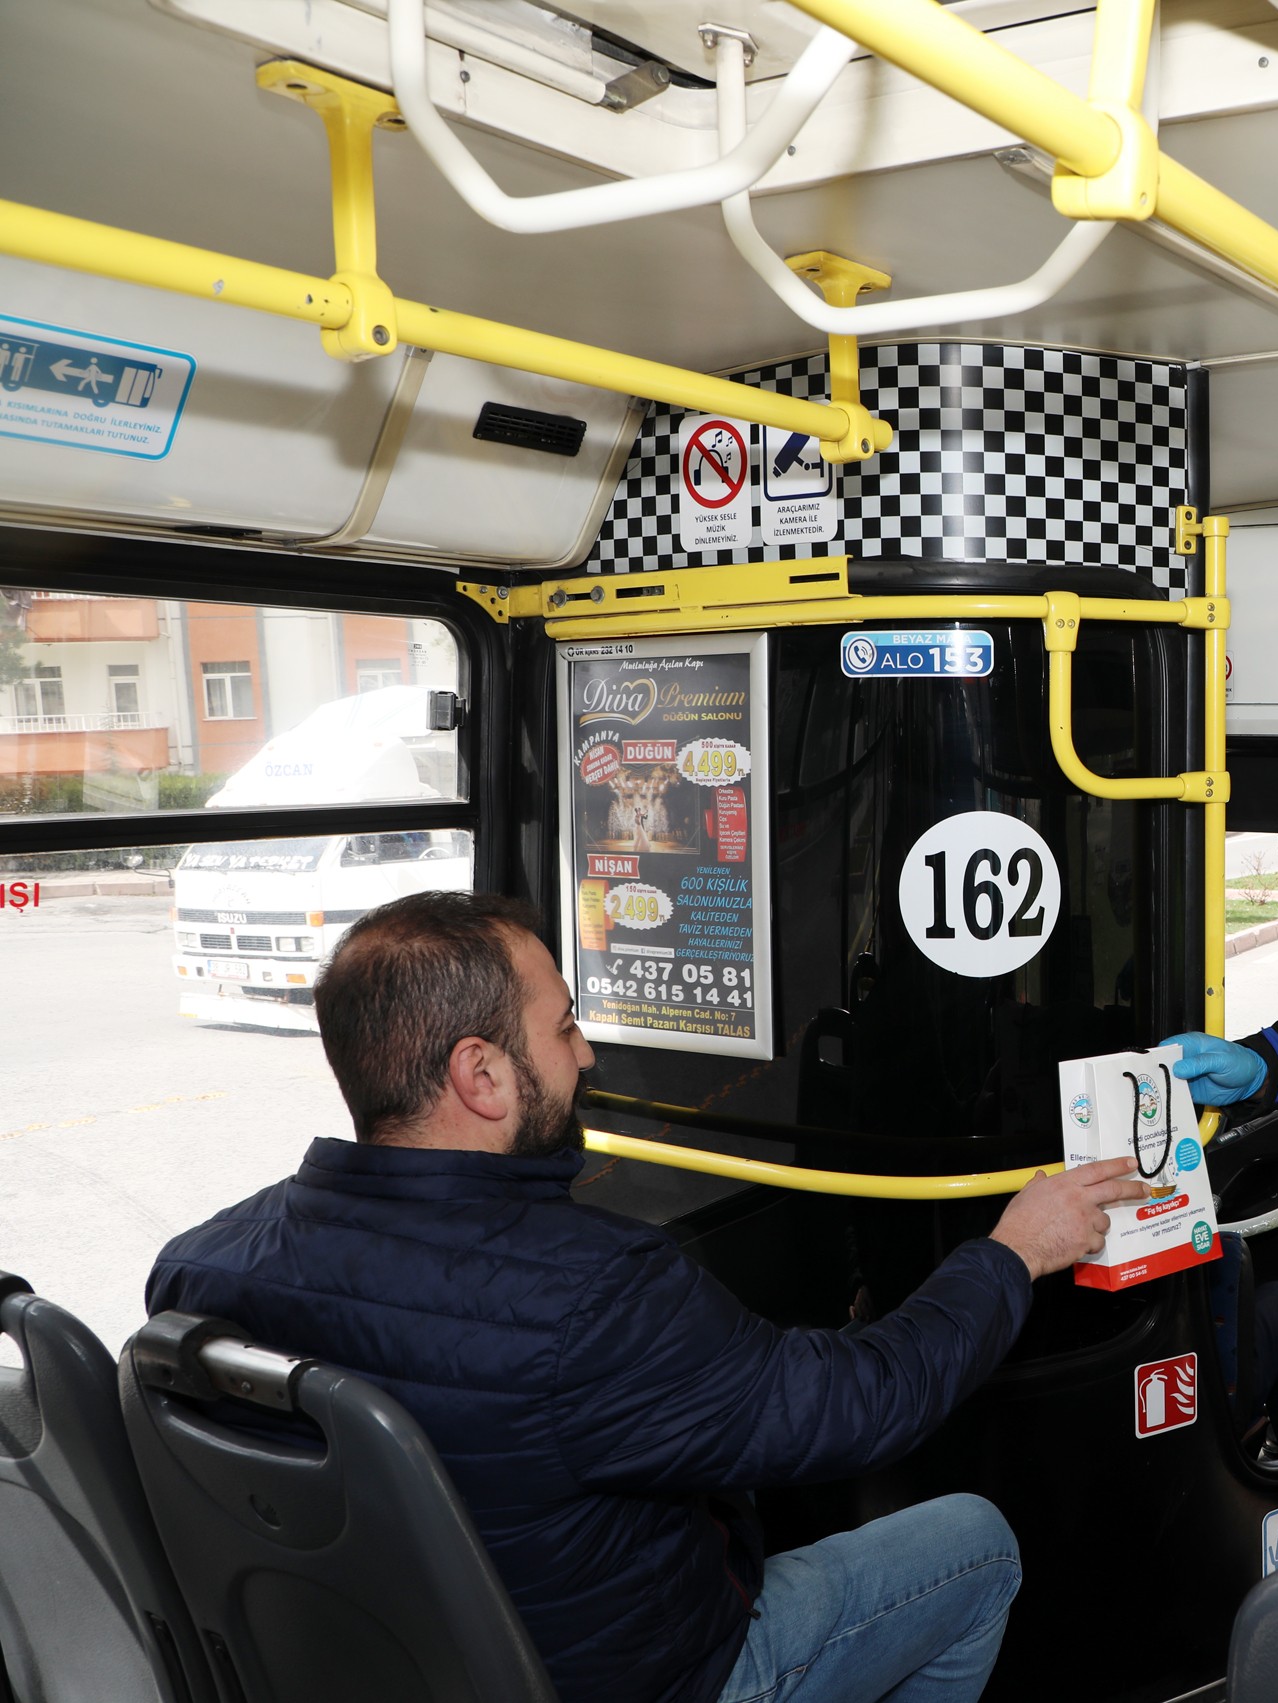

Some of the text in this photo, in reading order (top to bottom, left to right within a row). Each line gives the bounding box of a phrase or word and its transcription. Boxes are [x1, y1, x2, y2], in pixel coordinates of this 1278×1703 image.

[73, 410, 107, 424] DOĞRU
[41, 420, 104, 437] TUTAMAKLARI
[777, 503, 820, 515] ARAÇLARIMIZ
[694, 512, 737, 523] YÜKSEK SESLE
[779, 514, 818, 525] KAMERA İLE
[706, 524, 726, 533] MÜZİK
[773, 525, 825, 537] İZLENMEKTEDİR.
[694, 534, 738, 545] DİNLEMEYİNİZ.
[893, 634, 933, 644] BEYAZ
[615, 645, 623, 654] 14
[625, 644, 633, 653] 10
[658, 659, 683, 671] Açılan
[684, 657, 704, 671] Kapı
[880, 647, 984, 672] ALO 153
[582, 677, 746, 713] Diva Premium
[663, 712, 742, 721] DÜĞÜN SALONU
[574, 730, 619, 766] KAMPANYA
[626, 744, 672, 759] DÜĞÜN
[264, 760, 314, 777] ÖZCAN
[683, 750, 737, 777] 4.499
[595, 856, 632, 876] NİŞAN
[681, 874, 749, 895] 600 KİŞİLİK
[924, 847, 1046, 940] 162
[610, 894, 659, 922] 2.499
[676, 895, 753, 909] SALONUMUZLA
[217, 912, 247, 924] ISUZU
[690, 909, 739, 922] KALİTEDEN
[679, 922, 753, 937] TAVİZ VERMEDEN
[688, 938, 743, 949] HAYALLERİNİZİ
[629, 959, 751, 988] 437 05 81
[586, 976, 753, 1008] 0542 615 14 41
[602, 999, 736, 1021] Yenidoğan Mah. Alperen Cad. No: 7
[589, 1009, 751, 1038] Kapalı Semt Pazarı Karşısı TALAS
[1152, 1230, 1160, 1238] var
[1194, 1224, 1208, 1235] HAYAT
[1194, 1231, 1210, 1243] EVE
